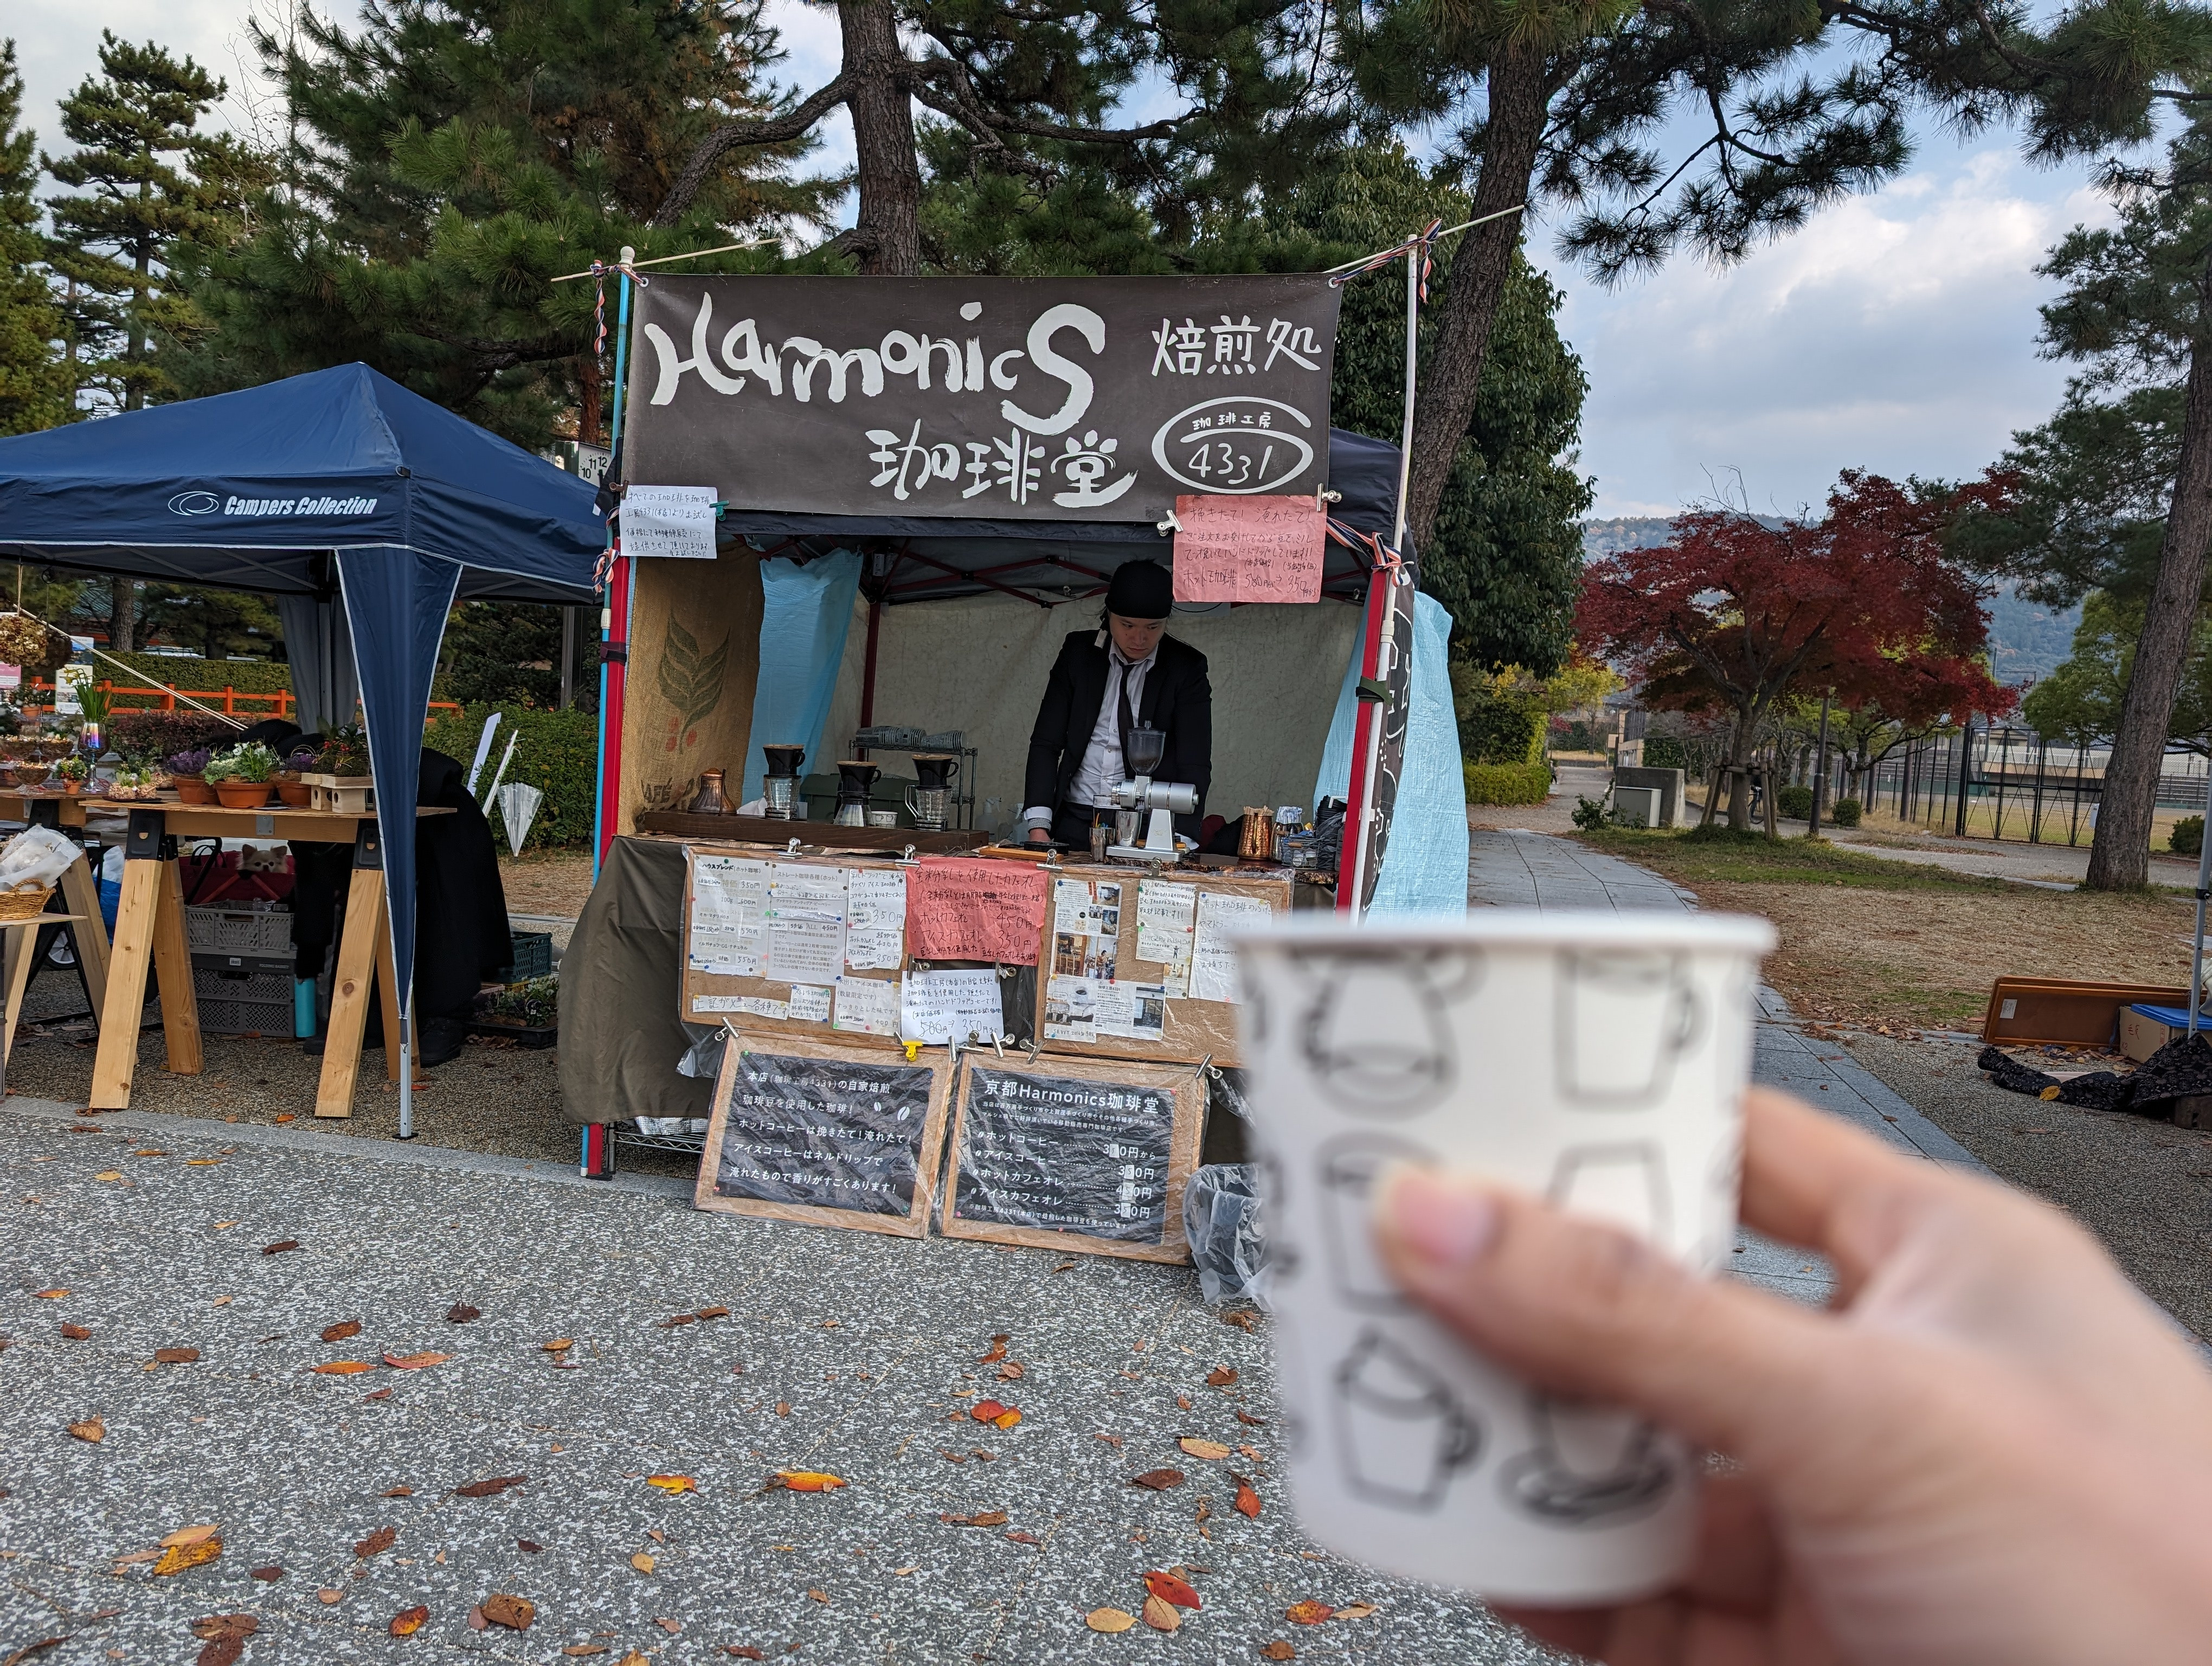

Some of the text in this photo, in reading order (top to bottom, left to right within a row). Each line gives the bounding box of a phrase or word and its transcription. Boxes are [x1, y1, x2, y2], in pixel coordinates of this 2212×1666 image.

[1152, 315, 1322, 376] 焙煎処
[1192, 412, 1271, 430] 珈琲工房
[589, 458, 596, 470] 11
[598, 456, 607, 467] 12
[866, 419, 1138, 508] 珈琲堂
[1188, 443, 1272, 484] 4331
[582, 467, 591, 478] 10
[224, 496, 377, 516] Campers Collection
[1190, 507, 1310, 523] 挽きたて! 淹れたて!
[1184, 567, 1237, 589] ホット珈琲
[741, 881, 760, 889] 350円
[777, 872, 838, 881] ストレート珈琲各種(ホット)
[873, 909, 903, 924] 350円
[996, 913, 1032, 931] 450円
[922, 929, 1031, 950] アイスカフェオレ 350円
[1141, 934, 1191, 945] SHIGERU KISHIDA
[738, 956, 756, 965] 550円
[877, 954, 899, 963] 350円
[838, 978, 885, 988] 水出しアイス珈琲
[838, 990, 877, 1001] (数量限定です)
[837, 1003, 898, 1016] すっきりとした味です!
[748, 1071, 891, 1094] 本店(珈琲工房4331)の自家焙煎
[742, 1094, 853, 1114] 珈琲豆を使用した珈琲!
[984, 1079, 1159, 1114] 京都Harmonics珈琲堂
[739, 1118, 911, 1144] ホットコーヒーは挽きたて!淹れたて!
[987, 1131, 1058, 1146] ホットコーヒー
[734, 1143, 883, 1167] アイスコーヒーはネルドリップで
[984, 1149, 1154, 1180] アイスコーヒー 350円
[730, 1166, 896, 1194] 淹れたもので香りがすごくあります!
[981, 1168, 1152, 1201] ホットカフェオレ 450円
[979, 1187, 1150, 1219] アイスカフェオレ 350円
